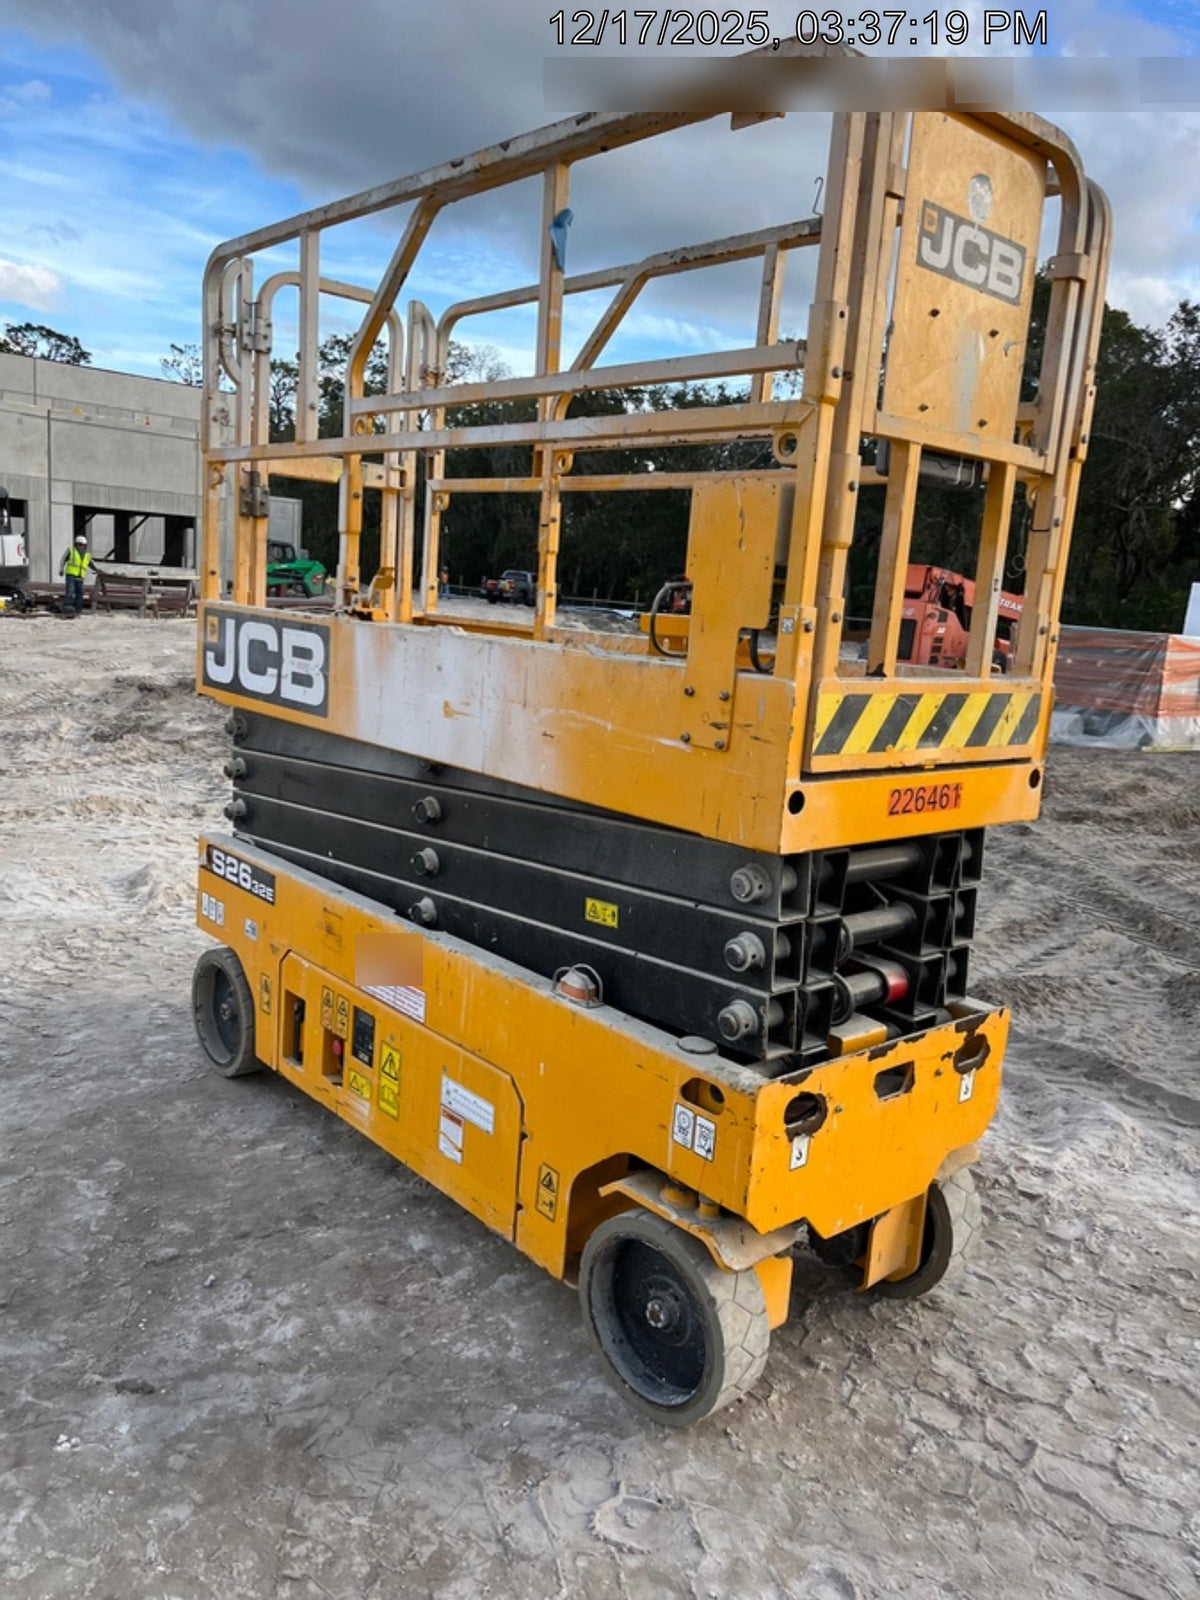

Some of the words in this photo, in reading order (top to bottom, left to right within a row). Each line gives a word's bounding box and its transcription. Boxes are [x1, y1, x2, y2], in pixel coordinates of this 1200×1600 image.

[920, 215, 1024, 299] JCB
[205, 618, 325, 706] JCB
[888, 783, 962, 816] 226461
